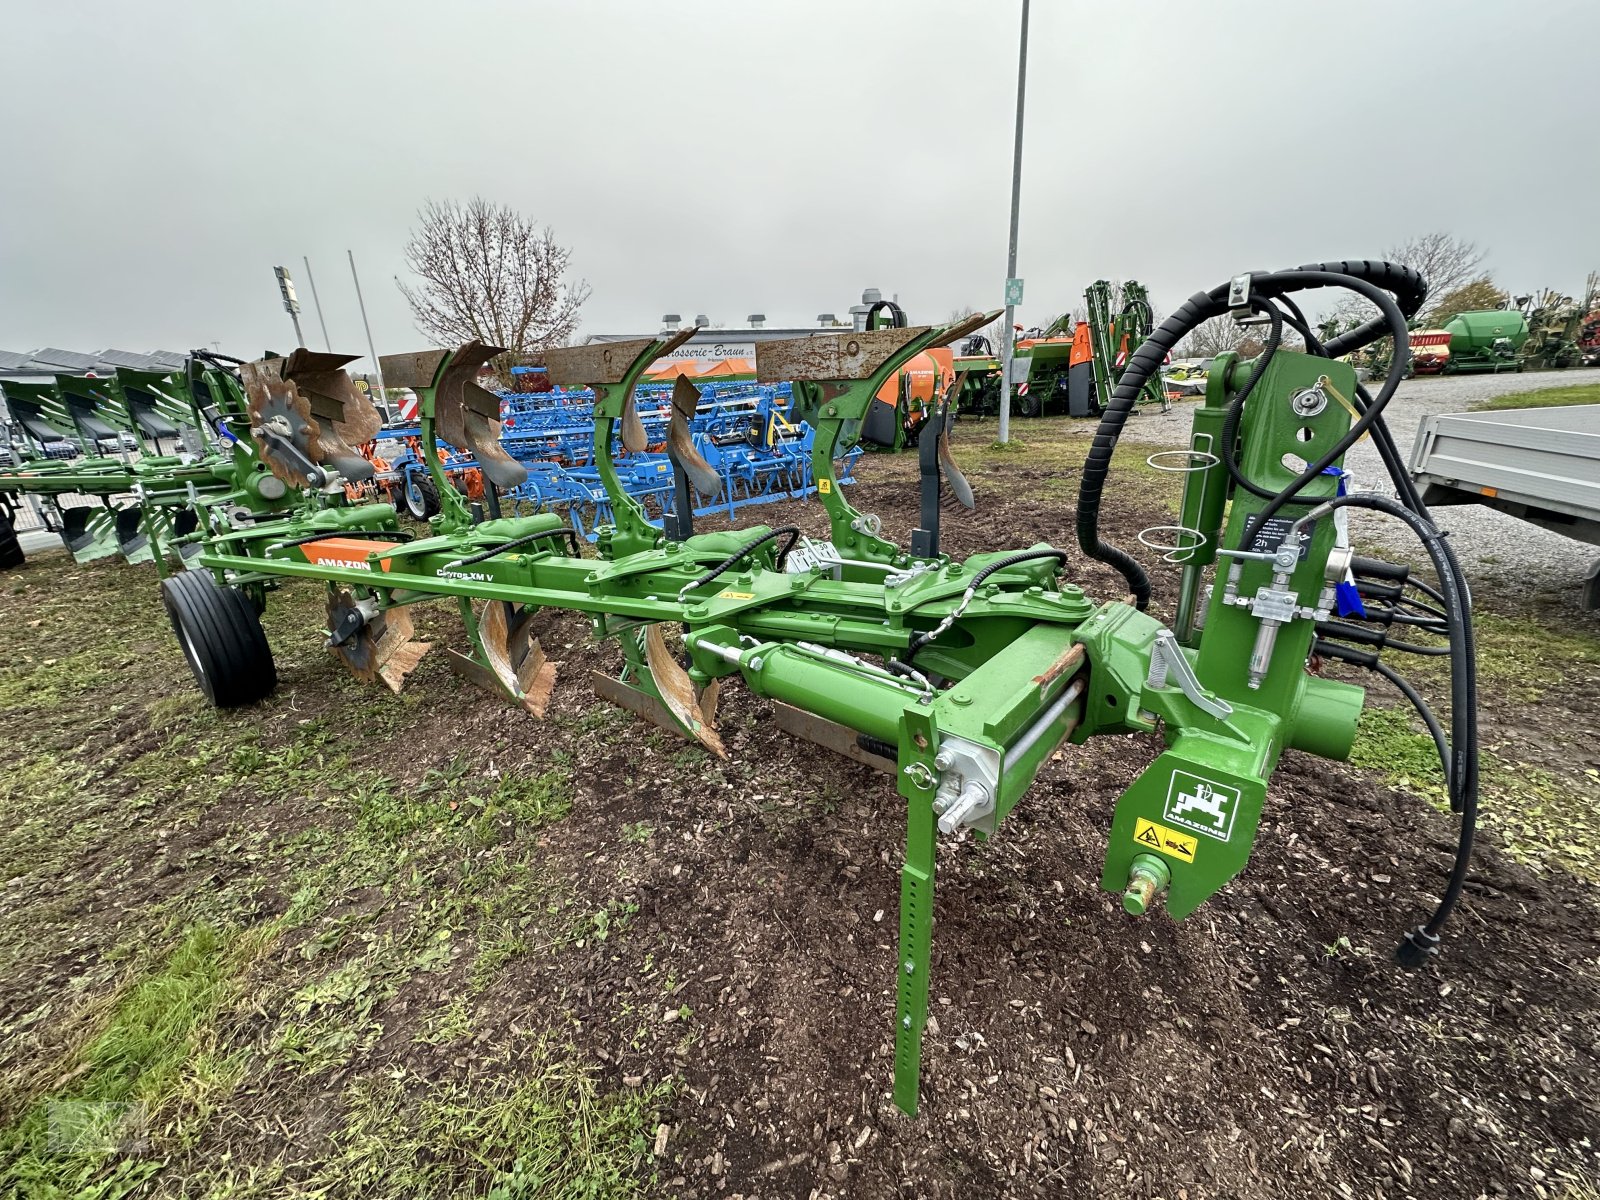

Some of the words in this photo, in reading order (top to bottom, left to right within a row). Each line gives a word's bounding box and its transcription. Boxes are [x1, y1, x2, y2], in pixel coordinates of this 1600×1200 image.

[667, 344, 744, 358] rosserie-Braun
[1254, 538, 1268, 548] 2h
[317, 557, 371, 571] AMAZON
[470, 572, 485, 581] XM
[486, 574, 494, 582] V
[1166, 813, 1227, 838] AMAZONE
